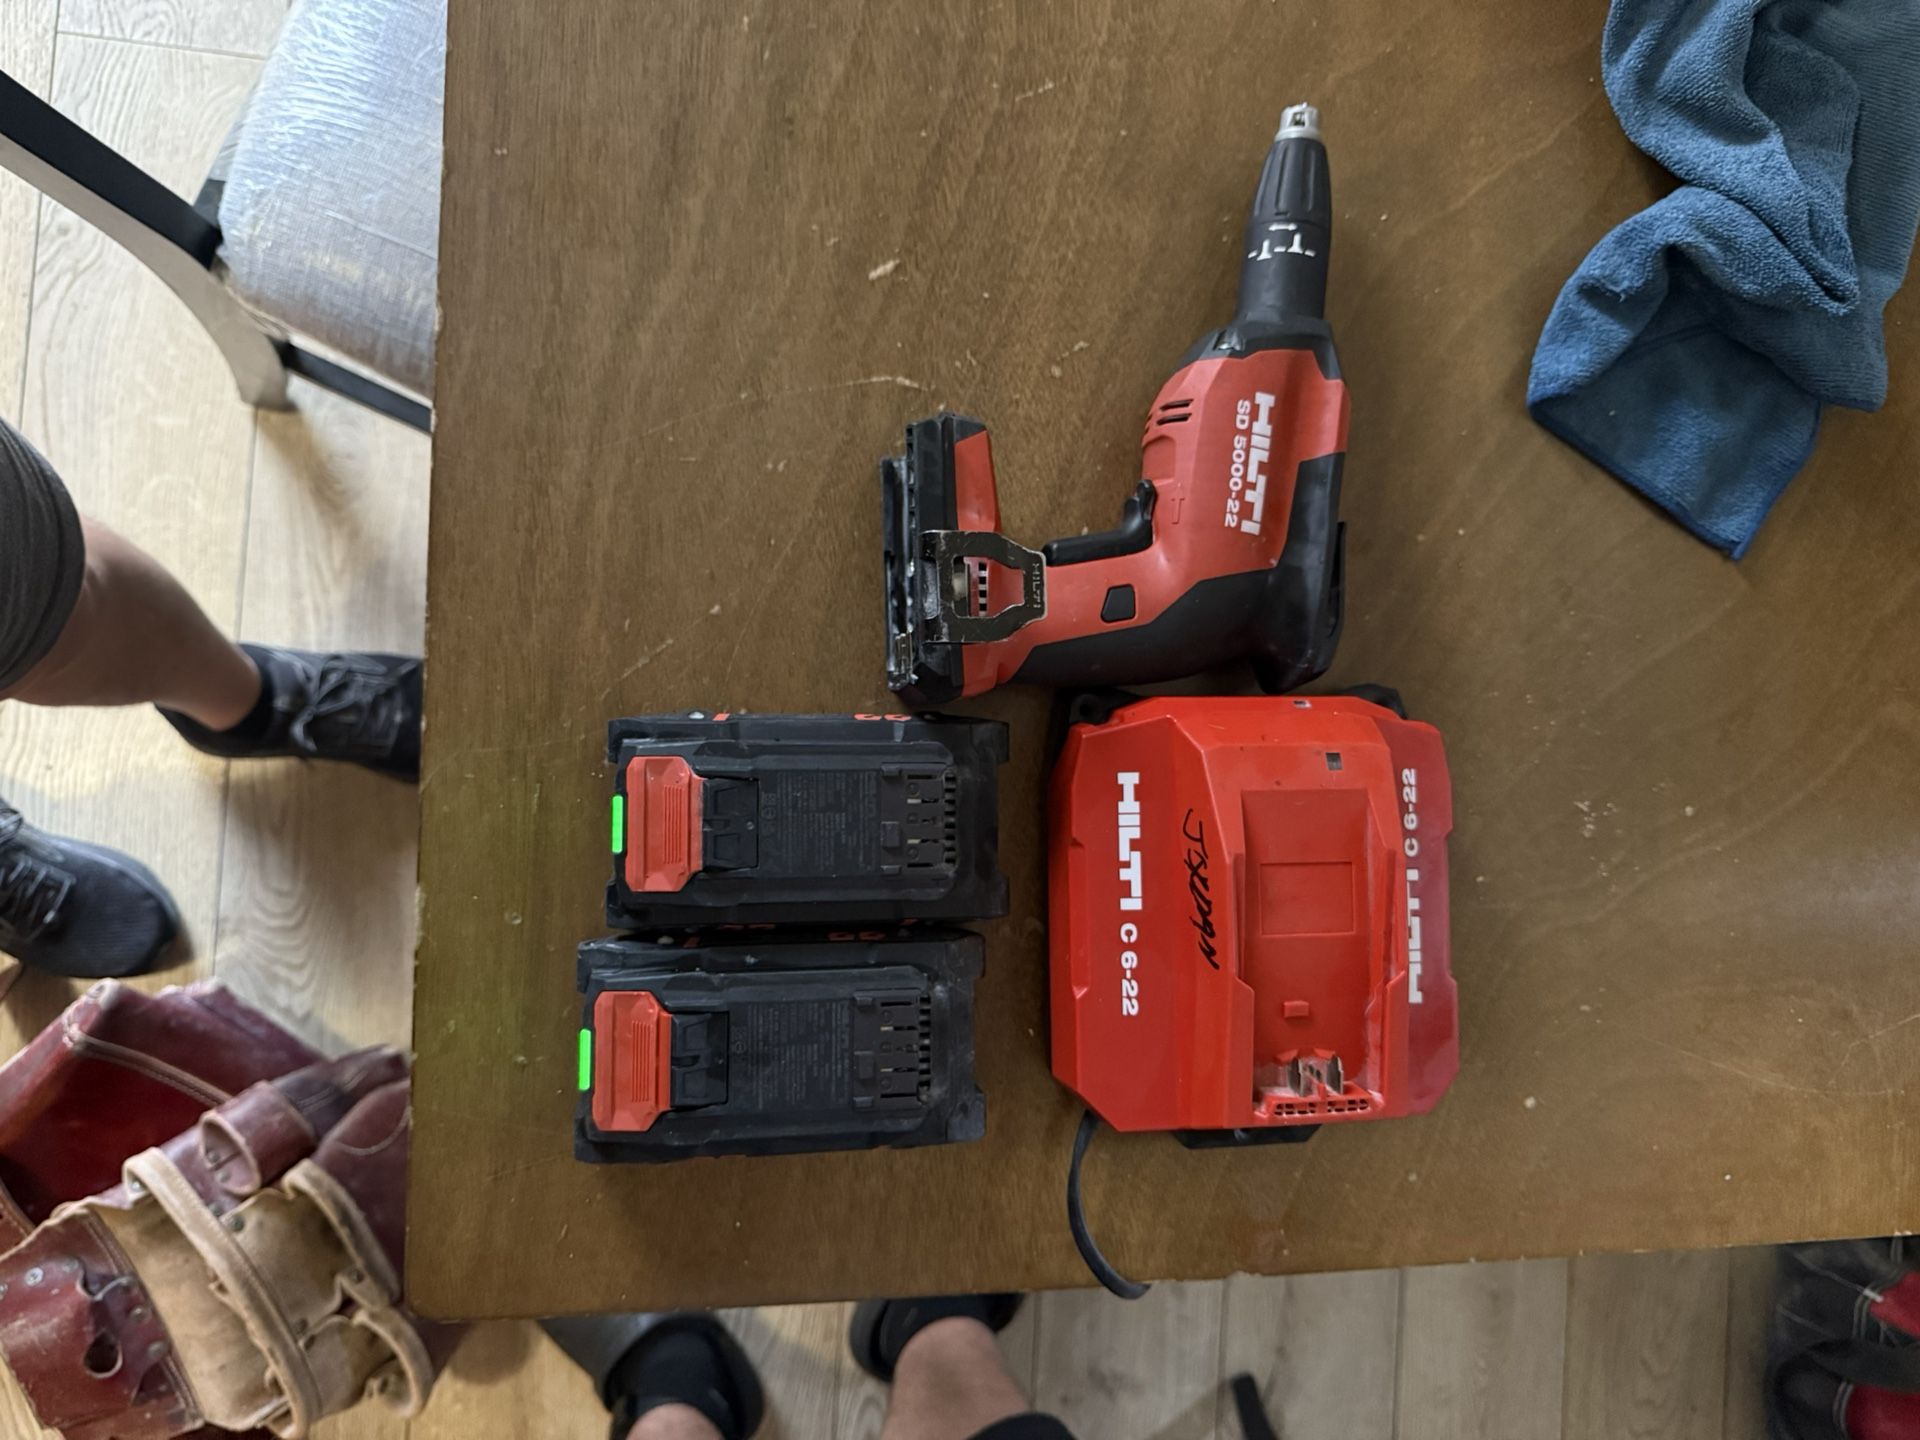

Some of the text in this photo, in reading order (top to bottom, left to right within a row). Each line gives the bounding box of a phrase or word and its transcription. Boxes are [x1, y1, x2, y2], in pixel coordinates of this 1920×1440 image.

[1224, 399, 1251, 528] SD 5000-22
[1240, 391, 1275, 536] HILTI
[1031, 563, 1041, 609] HILTI
[1401, 768, 1417, 830] 6-22
[1117, 772, 1142, 1016] HILTI C 6-22
[1404, 838, 1419, 857] C
